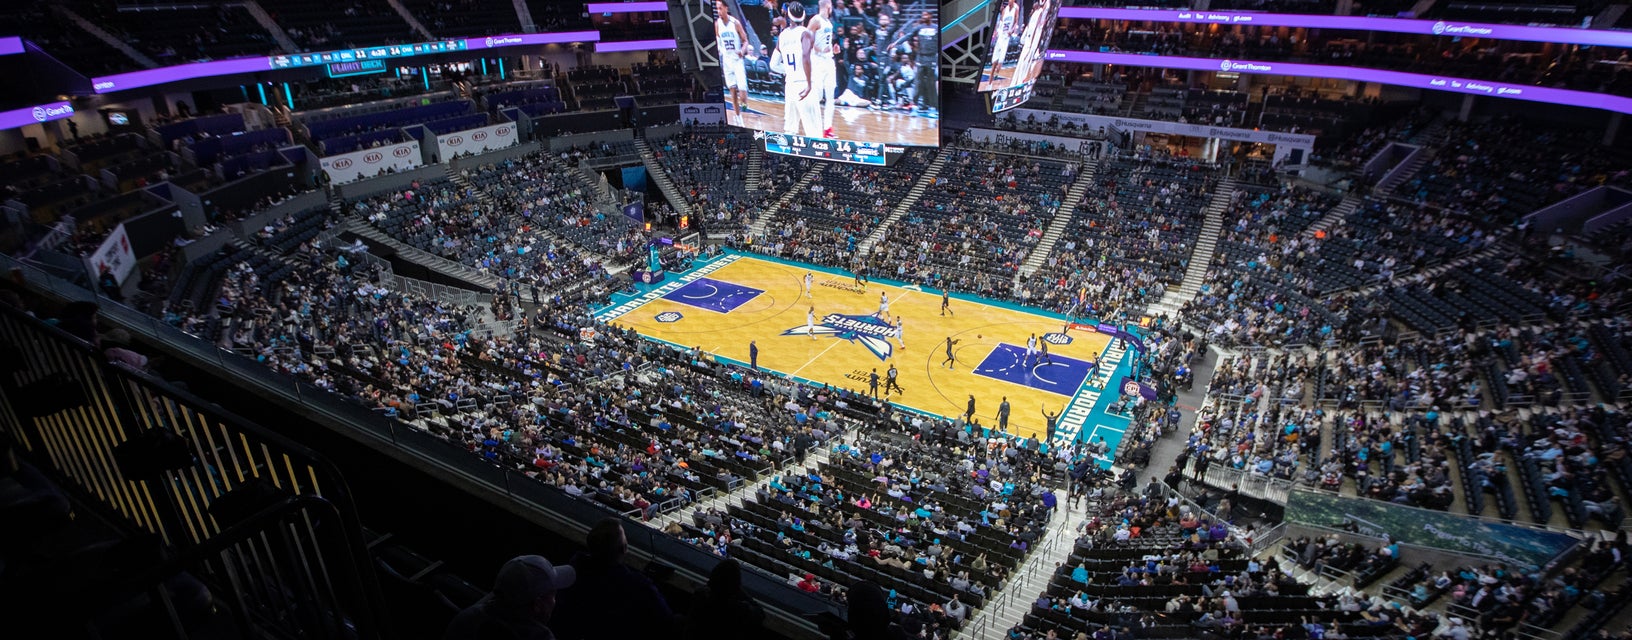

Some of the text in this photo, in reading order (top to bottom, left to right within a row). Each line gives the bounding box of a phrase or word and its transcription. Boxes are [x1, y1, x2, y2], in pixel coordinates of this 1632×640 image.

[787, 53, 796, 71] 4
[792, 136, 806, 147] 11
[836, 141, 851, 152] 14
[594, 254, 741, 322] CHARLOTTE HORNETS
[824, 314, 897, 337] HORNETS
